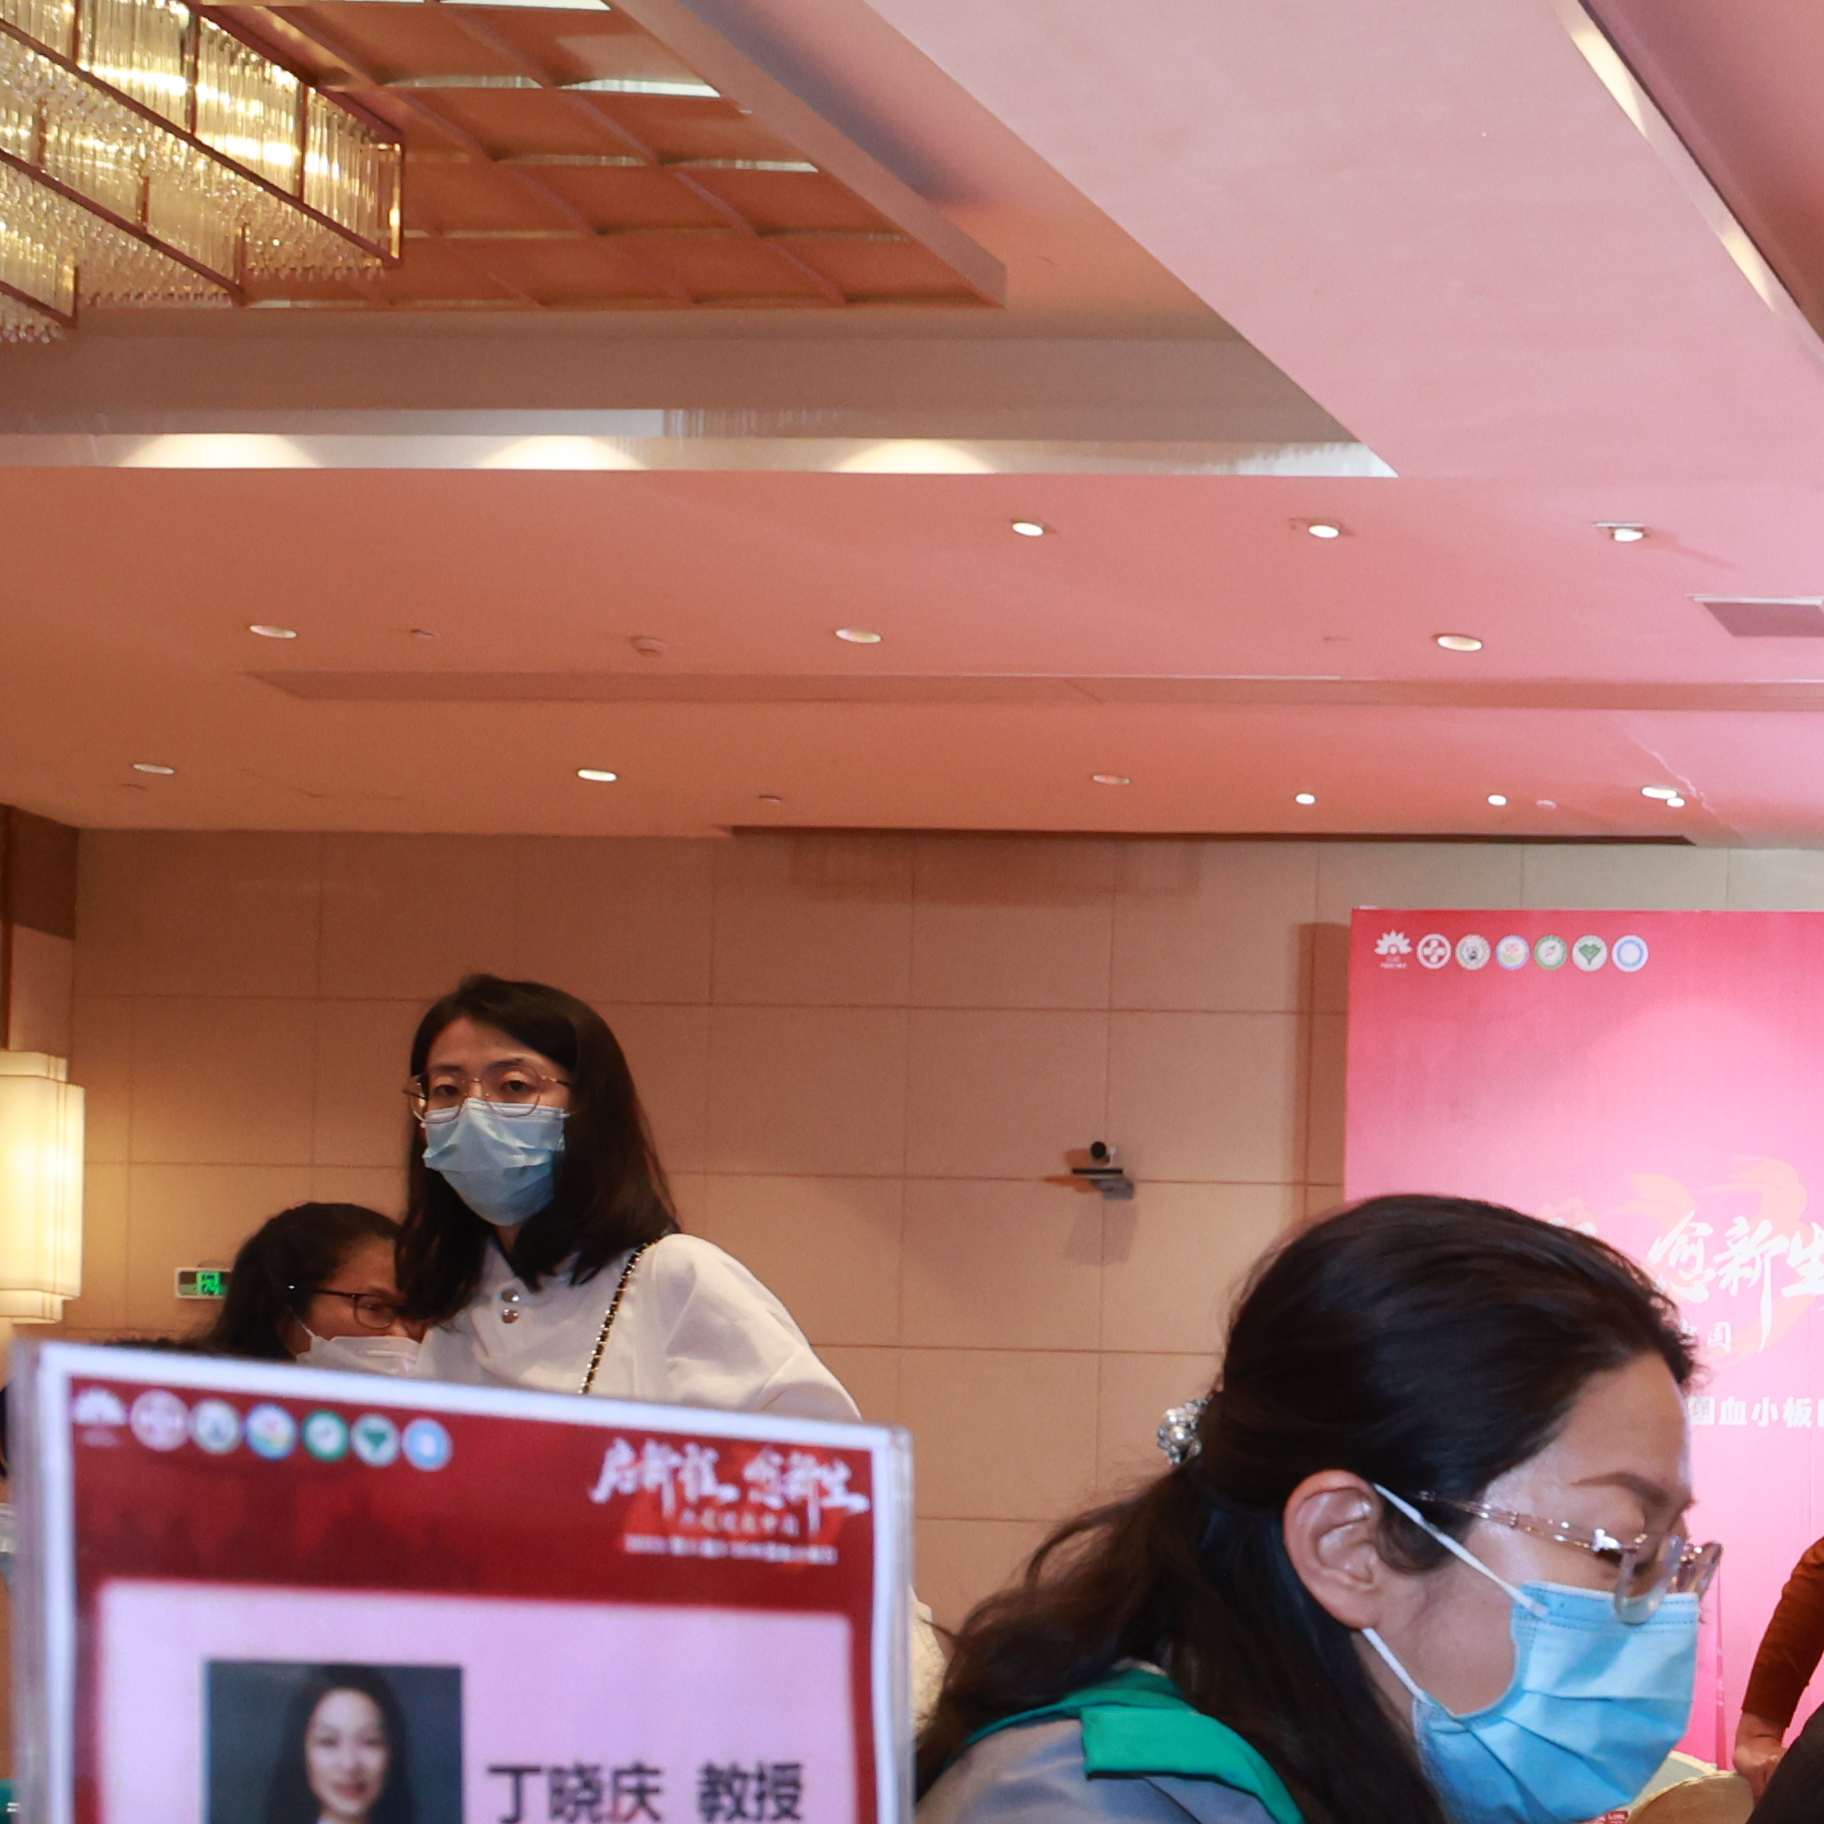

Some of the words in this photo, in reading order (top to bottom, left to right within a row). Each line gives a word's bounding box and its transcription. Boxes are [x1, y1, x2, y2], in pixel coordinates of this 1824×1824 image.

[488, 1762, 662, 1824] 丁晓庆
[698, 1761, 804, 1824] 教授
